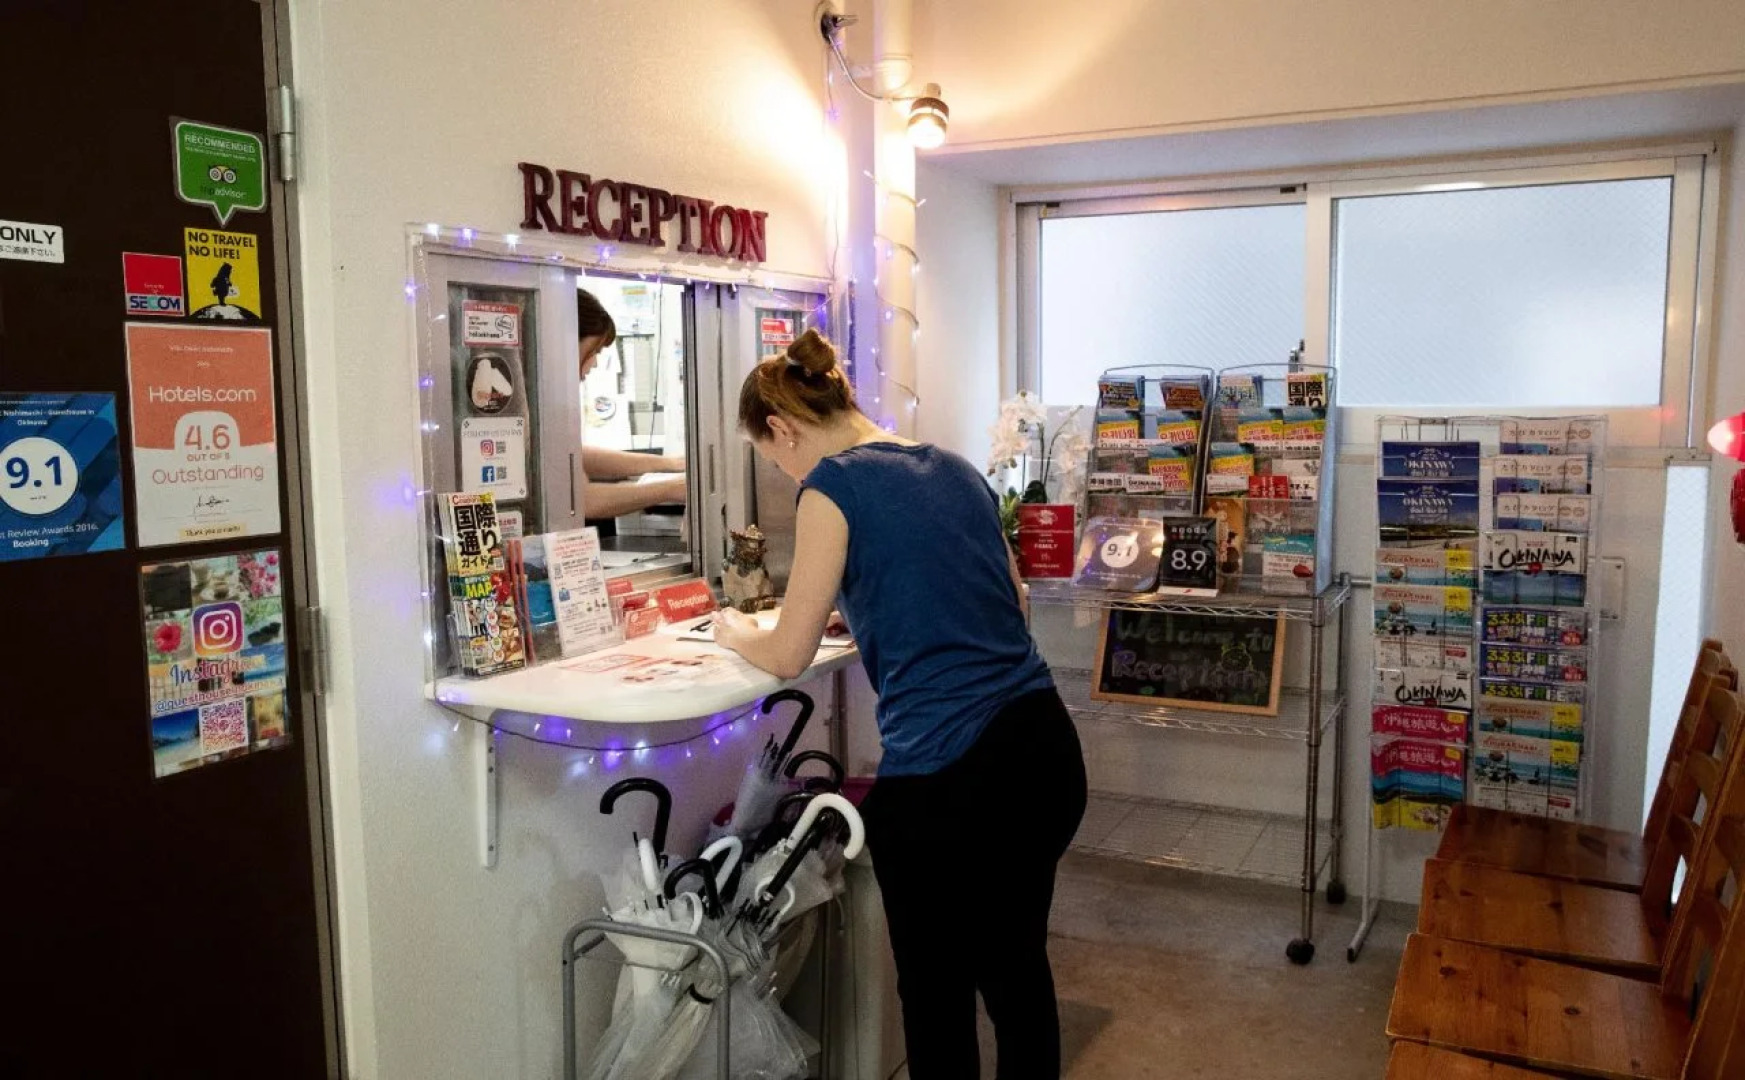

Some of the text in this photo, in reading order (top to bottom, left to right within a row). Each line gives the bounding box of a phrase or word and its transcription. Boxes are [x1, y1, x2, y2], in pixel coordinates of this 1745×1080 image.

[184, 134, 255, 154] RECOMMENDED
[518, 162, 768, 262] RECEPTION
[0, 226, 56, 245] ONLY
[188, 231, 255, 248] NO TRAVEL
[188, 245, 240, 260] NO LIFE!
[130, 295, 181, 311] SECOM
[149, 386, 257, 403] Hotels.com
[184, 423, 231, 450] 4.6
[187, 453, 207, 462] OUT
[5, 456, 63, 489] 9.1
[152, 464, 264, 485] Outstanding
[453, 502, 497, 531] 国際
[8, 528, 39, 538] Review
[42, 525, 74, 535] Awards
[1106, 543, 1132, 557] 9.1
[1498, 548, 1575, 568] OKINAWA
[1171, 549, 1207, 571] 8.9
[465, 582, 492, 599] MAP
[667, 593, 711, 609] Reception
[1395, 684, 1467, 702] OKINAWA
